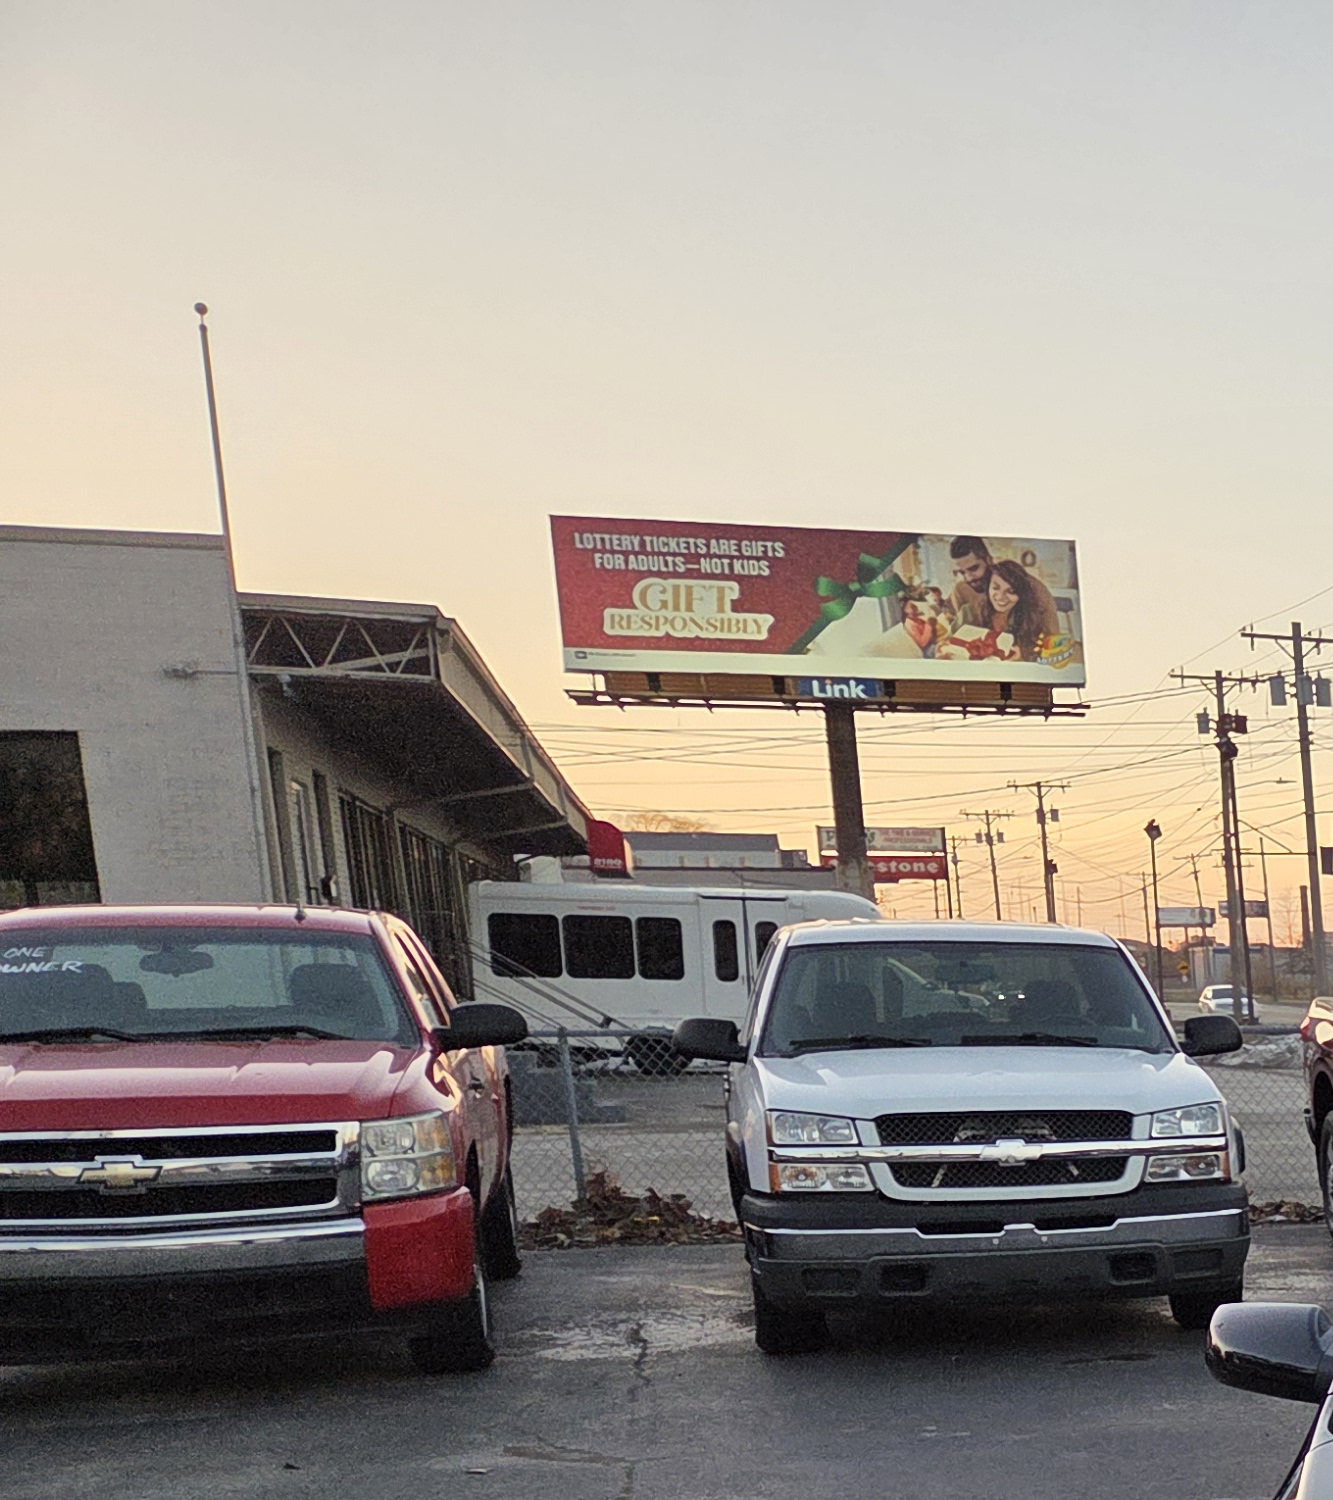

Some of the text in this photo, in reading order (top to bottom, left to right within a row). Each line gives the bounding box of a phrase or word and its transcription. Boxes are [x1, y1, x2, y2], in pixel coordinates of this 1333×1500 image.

[574, 532, 785, 558] LOTTERY TICKETS ARE GIFTS
[594, 553, 625, 570] FOR
[733, 560, 770, 576] KIDS
[638, 581, 735, 614] GIFT
[609, 613, 768, 635] RESPONSIBLY
[812, 679, 868, 698] Link
[3, 946, 50, 959] ONE
[0, 960, 83, 973] WNER
